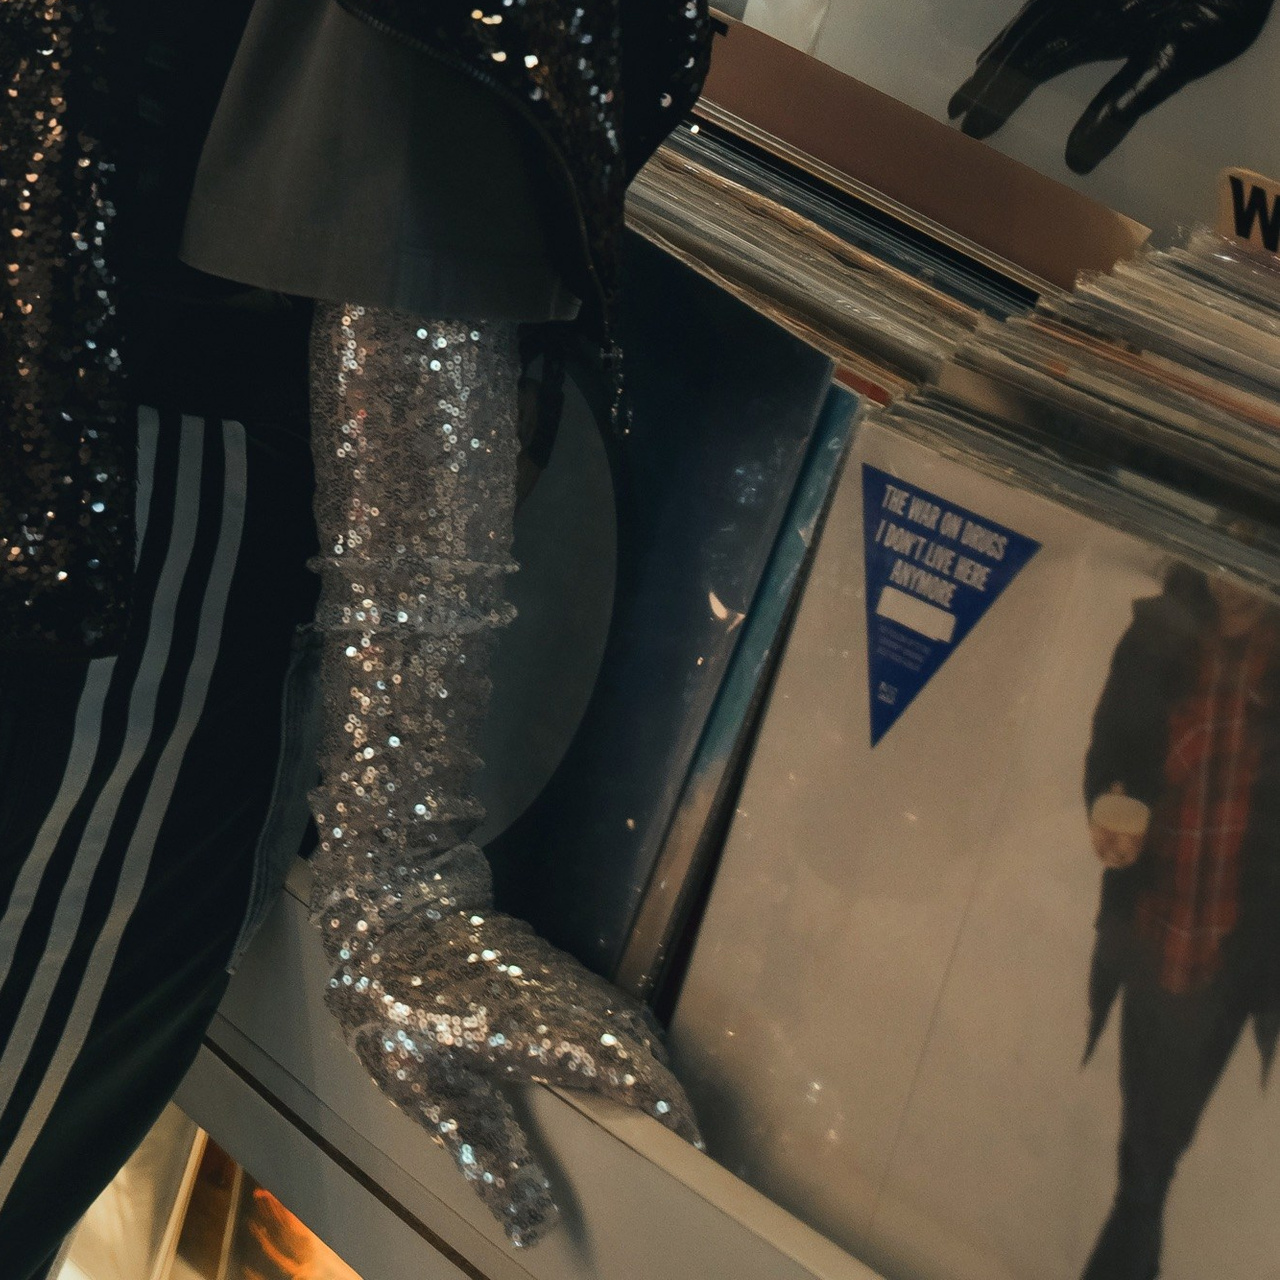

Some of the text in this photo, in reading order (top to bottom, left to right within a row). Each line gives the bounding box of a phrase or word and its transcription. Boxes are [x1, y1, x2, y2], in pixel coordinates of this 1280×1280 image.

[875, 519, 991, 592] I DON'T LIVE HERE
[882, 484, 1008, 562] THE WAR ON DRUGS
[890, 559, 957, 609] ANYMORE
